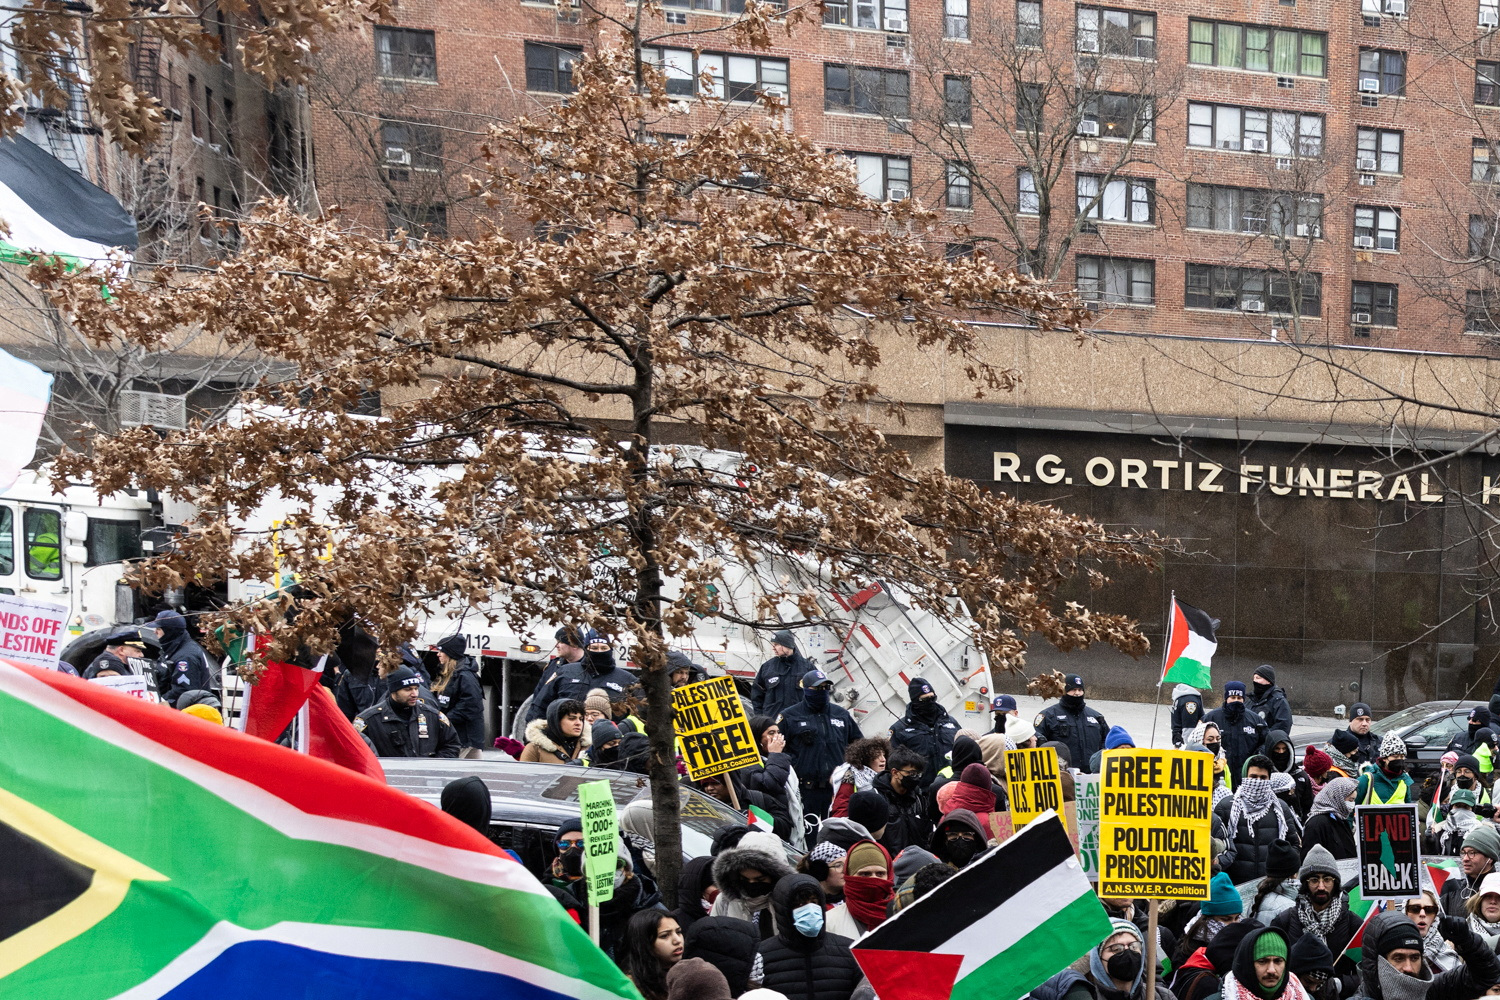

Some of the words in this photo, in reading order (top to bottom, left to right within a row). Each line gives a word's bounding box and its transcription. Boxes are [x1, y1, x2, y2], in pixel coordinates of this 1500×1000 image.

[993, 451, 1073, 485] R.G.
[1085, 456, 1224, 493] ORTIZ
[1239, 464, 1443, 503] FUNERAL
[0, 611, 29, 632] NDS
[32, 617, 62, 636] OFF
[0, 632, 58, 656] ESTINE
[675, 704, 718, 733] WILL
[716, 696, 743, 721] BE
[681, 722, 754, 770] FREE!
[730, 755, 758, 768] Coalition
[1007, 752, 1026, 782] END
[1030, 750, 1057, 781] ALL
[1105, 756, 1163, 789] FREE
[1169, 758, 1209, 791] ALL
[1012, 783, 1031, 813] U.S.
[1034, 782, 1059, 812] AID
[1104, 792, 1209, 820] PALESTINIAN
[1114, 827, 1199, 853] POLITICAL
[1364, 814, 1411, 842] LAND
[590, 841, 614, 857] GAZA
[1105, 854, 1206, 881] PRISONERS!
[1367, 863, 1413, 891] BACK
[1105, 884, 1164, 894] A.N.S.W.E.R.
[1165, 885, 1205, 896] Coalition
